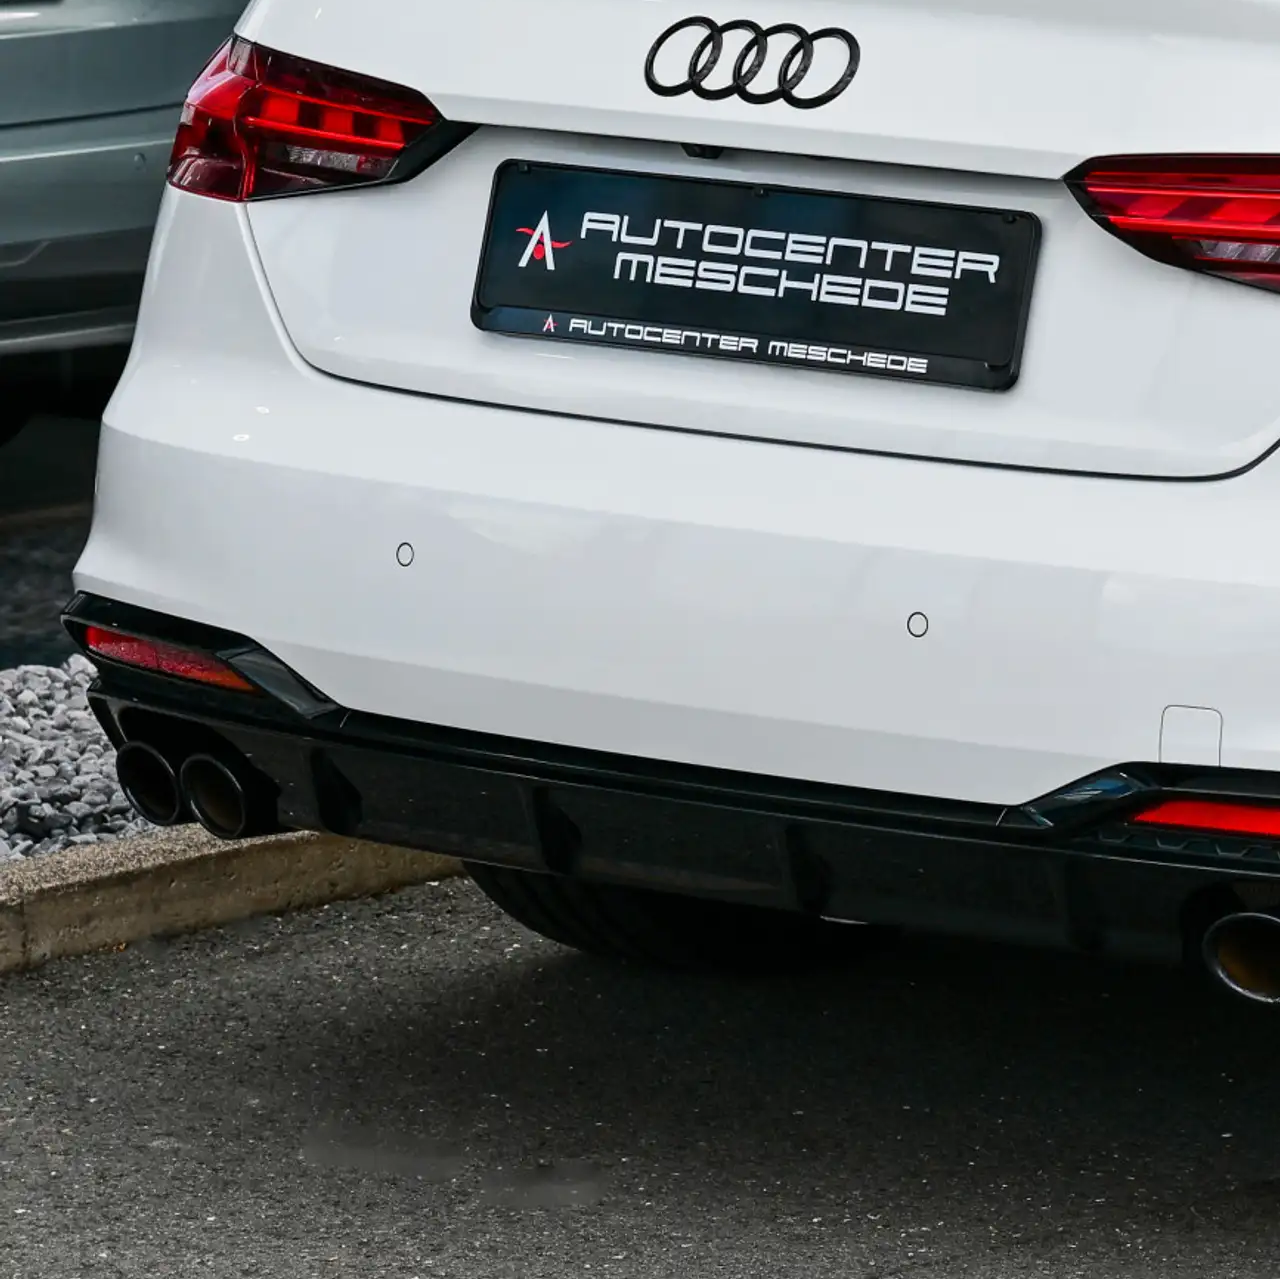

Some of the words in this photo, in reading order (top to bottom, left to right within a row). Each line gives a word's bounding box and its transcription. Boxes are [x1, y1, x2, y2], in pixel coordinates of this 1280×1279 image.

[580, 211, 1000, 284] AUTOCENTER
[613, 251, 950, 316] MESCHEDE
[568, 317, 759, 354] AUTOCENTER
[767, 340, 929, 374] MESCHEDE
